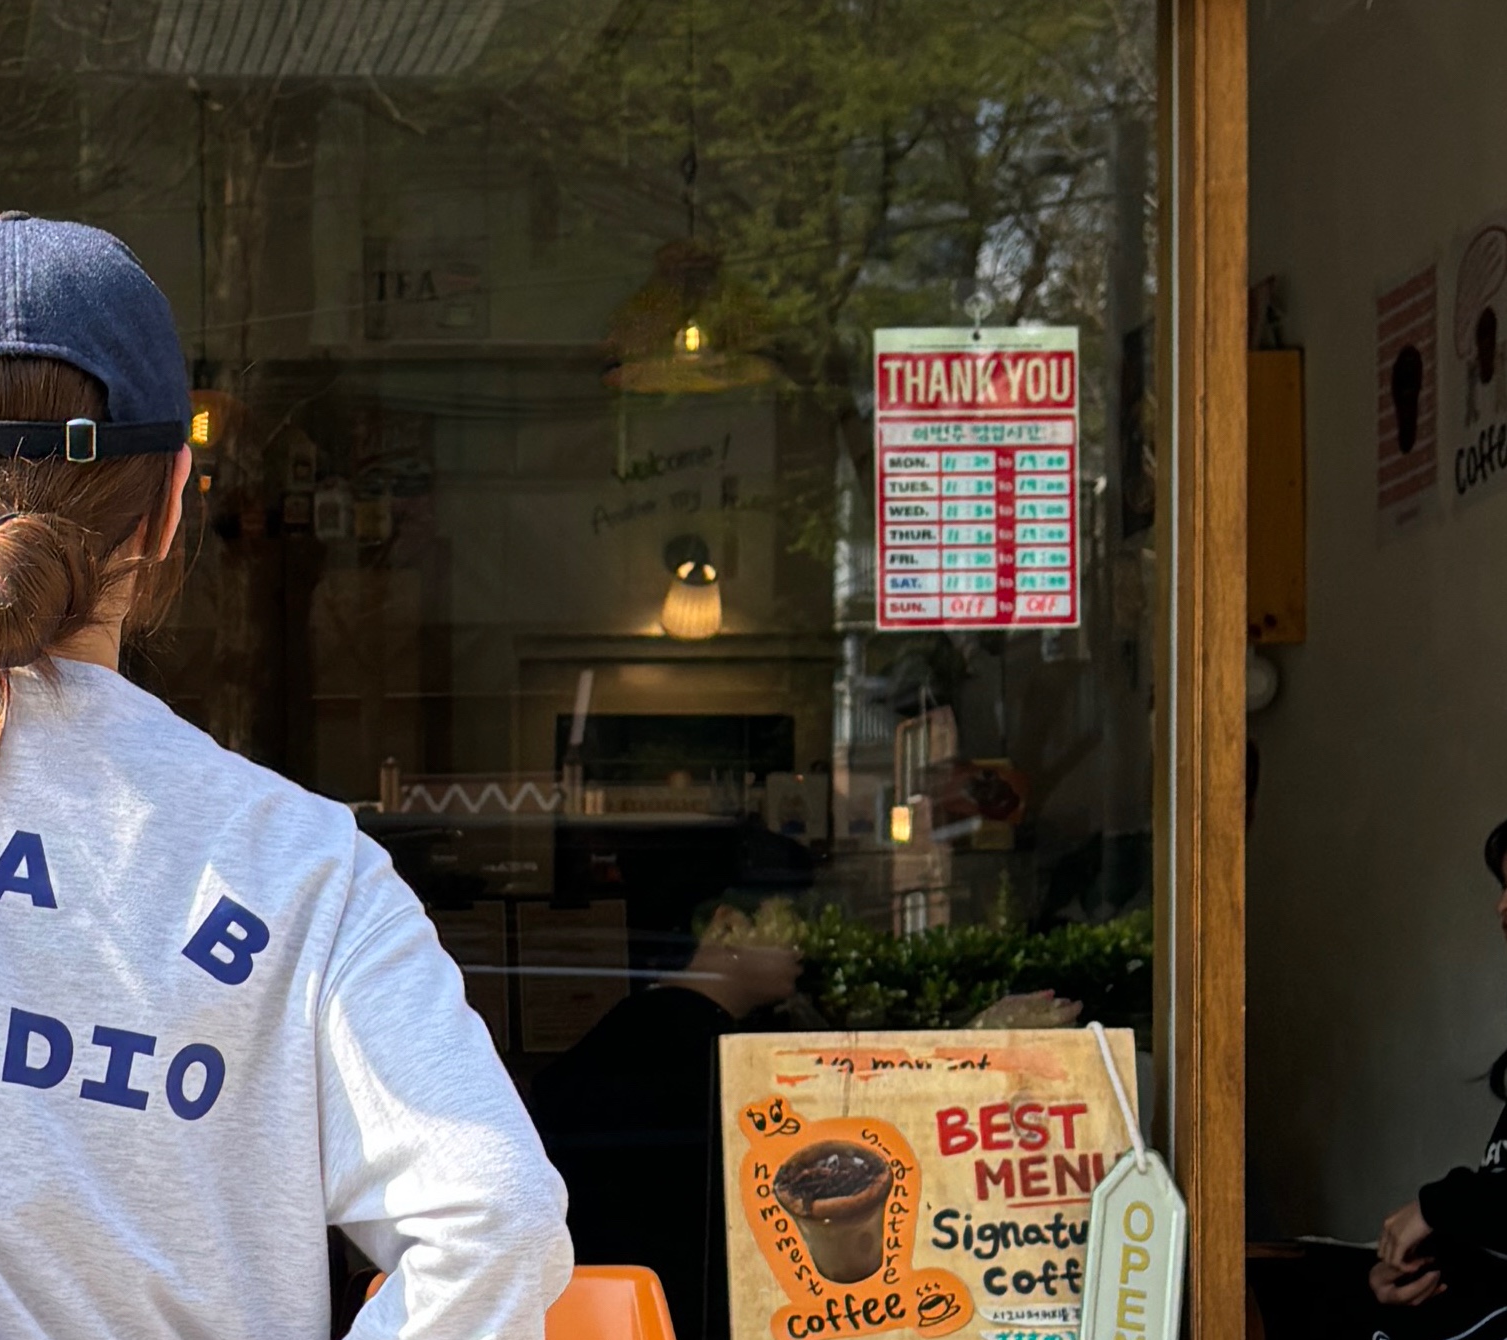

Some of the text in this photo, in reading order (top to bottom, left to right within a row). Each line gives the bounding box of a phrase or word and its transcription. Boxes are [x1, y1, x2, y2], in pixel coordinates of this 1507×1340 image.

[882, 357, 1072, 403] THANK YOU
[889, 457, 930, 469] MON.
[889, 481, 934, 493] TUES.
[889, 506, 929, 516] WED.
[889, 529, 937, 541] THUR.
[181, 894, 270, 986] B
[935, 1102, 1088, 1157] BEST
[931, 1208, 1090, 1260] Signatu
[982, 1257, 1083, 1297] coff
[787, 1293, 906, 1339] coffee
